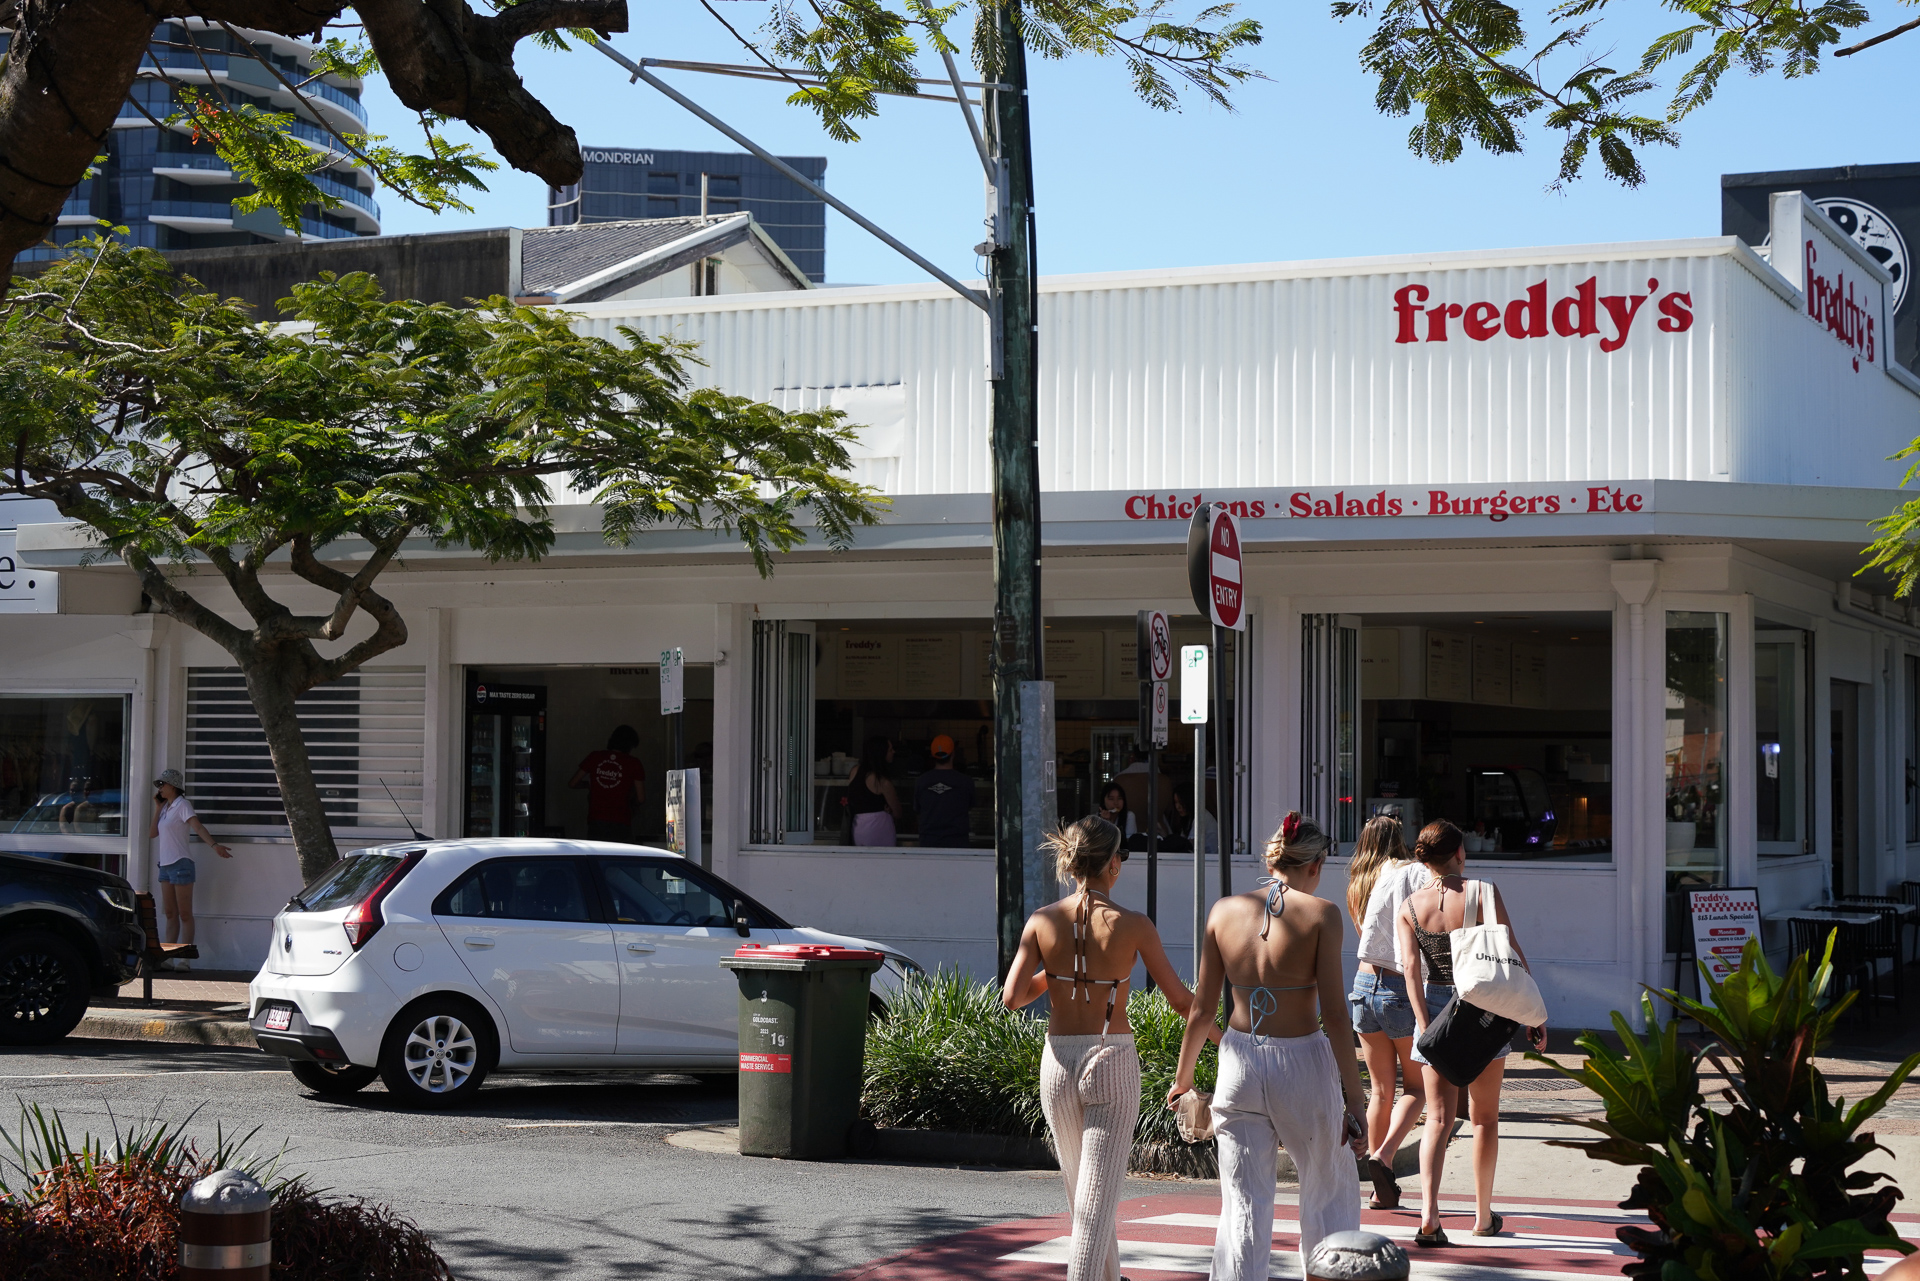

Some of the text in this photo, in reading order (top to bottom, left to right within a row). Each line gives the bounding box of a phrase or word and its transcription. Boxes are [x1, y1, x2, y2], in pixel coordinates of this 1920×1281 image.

[583, 151, 654, 165] MONDRIAN
[1806, 240, 1874, 373] freddy's
[1393, 276, 1693, 353] freddy's
[1289, 490, 1403, 518] Salads
[1427, 490, 1561, 522] Burgers
[1586, 486, 1643, 513] Etc
[1220, 527, 1230, 548] NO
[1215, 584, 1238, 608] ENTRY
[845, 640, 881, 650] freddy's
[1694, 893, 1730, 903] freddy's
[1729, 913, 1754, 921] Specials
[761, 990, 768, 1003] 3
[771, 1032, 785, 1047] 19
[740, 1055, 769, 1063] COMMERCIAL
[740, 1062, 774, 1071] WASTE SERVICE
